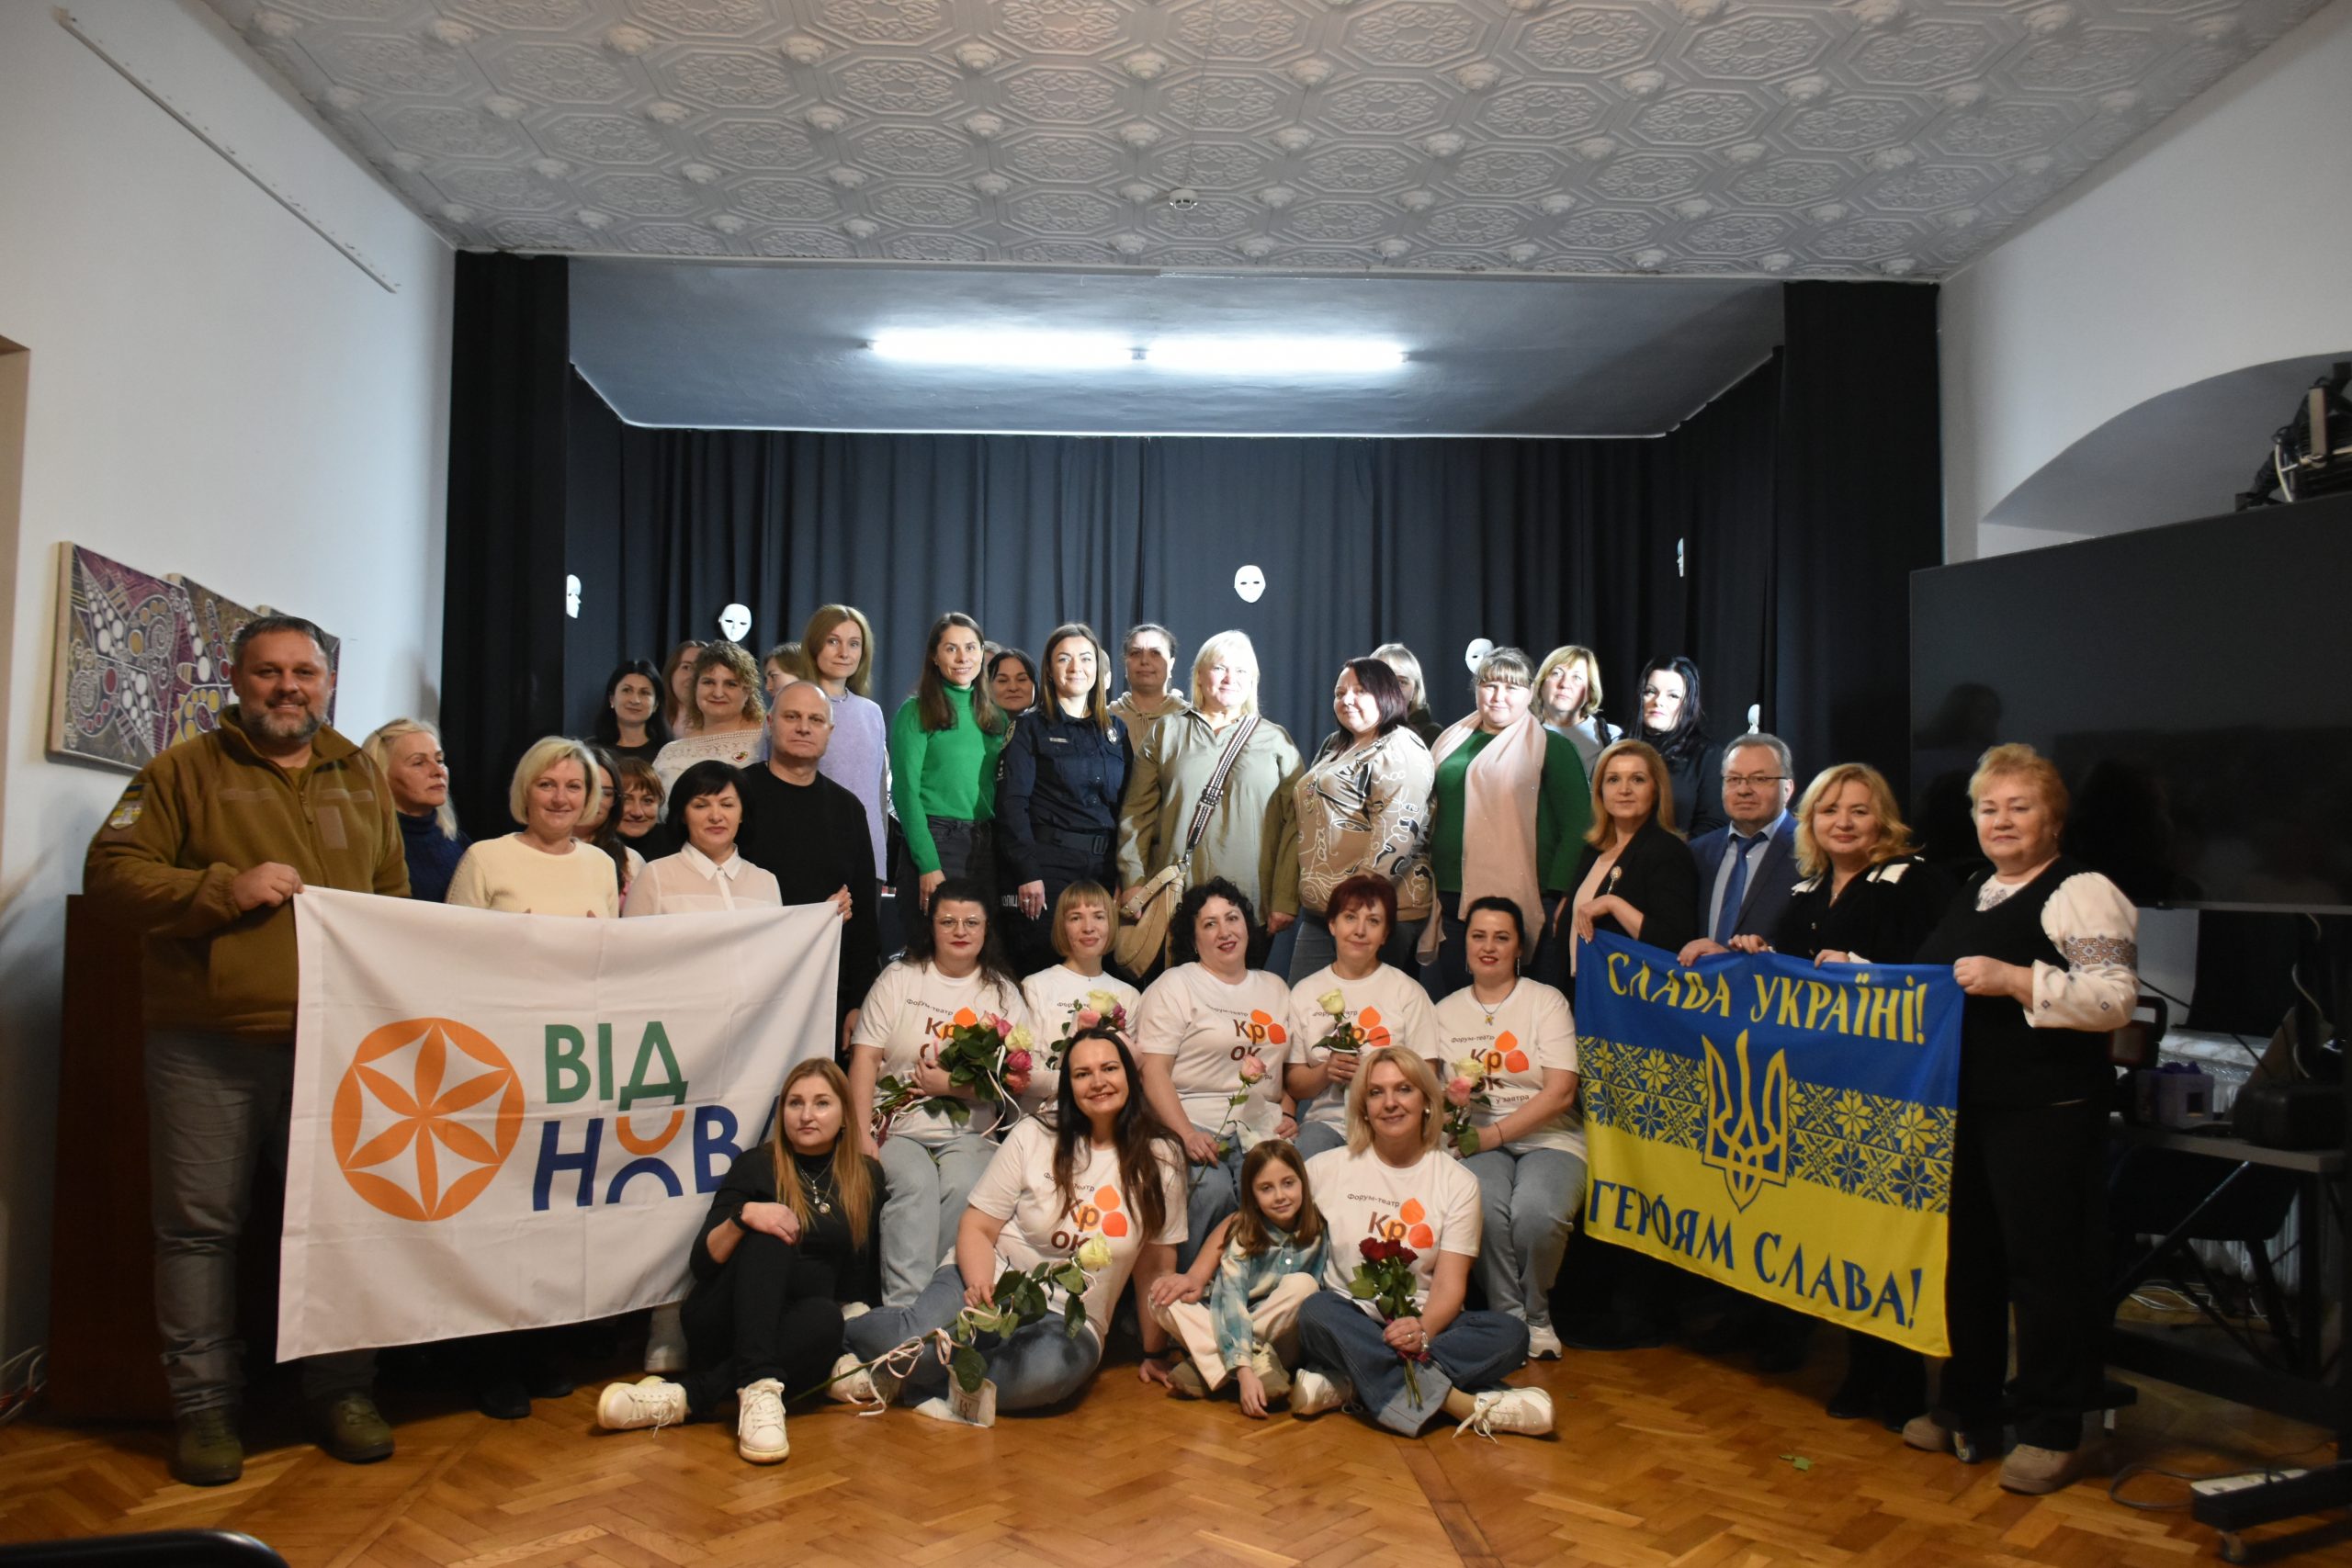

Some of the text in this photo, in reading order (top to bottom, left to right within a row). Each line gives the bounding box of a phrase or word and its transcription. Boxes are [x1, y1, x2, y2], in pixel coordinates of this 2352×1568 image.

[1607, 952, 1928, 1045] СЛАВА УКРАЇНІ!
[1233, 1019, 1265, 1044] Кр
[1451, 1034, 1495, 1043] Форум-театр
[545, 1021, 688, 1111] ВІД
[1503, 1094, 1530, 1102] завтра
[1347, 1193, 1400, 1208] Форум-театр
[1589, 1179, 1923, 1329] ГЕРОЯМ СЛАВА!
